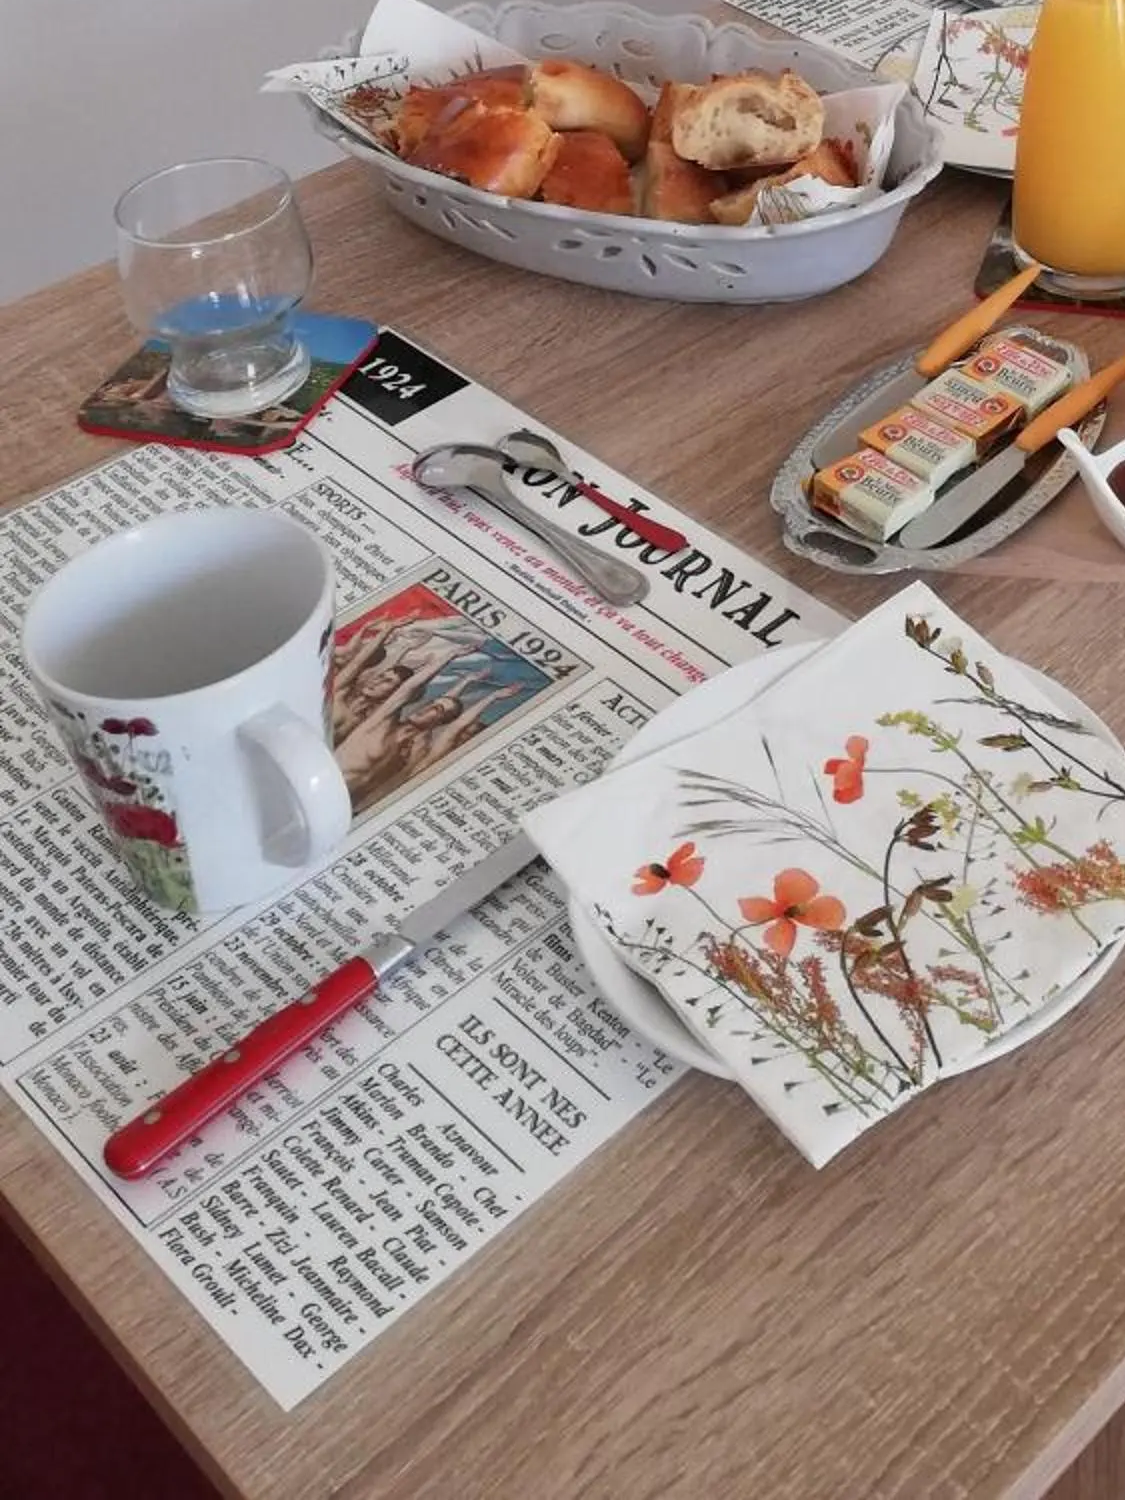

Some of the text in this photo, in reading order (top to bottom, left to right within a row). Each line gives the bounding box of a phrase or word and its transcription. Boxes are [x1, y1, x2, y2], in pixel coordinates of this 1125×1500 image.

[357, 354, 418, 401] 1924
[311, 483, 366, 520] SPORTS
[421, 568, 507, 628] PARIS
[507, 631, 581, 681] 1924
[540, 565, 589, 598] monde
[630, 626, 666, 652] tout
[32, 825, 72, 866] Marquis
[71, 836, 102, 868] vaccin
[18, 941, 53, 976] mètres
[23, 915, 50, 939] avec
[33, 892, 69, 926] monde
[81, 941, 124, 984] distance
[66, 895, 111, 942] Argentin,
[542, 933, 573, 962] films
[25, 981, 51, 1006] tour
[176, 989, 208, 1015] juin
[496, 970, 536, 1012] Miracle
[533, 1009, 555, 1030] des
[511, 956, 548, 993] Voleur
[545, 961, 585, 996] Buster
[587, 997, 630, 1038] Keaton
[107, 1050, 137, 1074] août
[436, 1034, 569, 1155] CETTE ANNEE
[458, 1014, 586, 1128] ILS SONT NES
[338, 1093, 479, 1226] Atkins Truman Capote
[358, 1076, 507, 1218] Marlon Brando Chet
[377, 1062, 498, 1175] Charles Aznavour
[260, 1148, 404, 1291] Sautet Lauren Bacall
[282, 1135, 429, 1283] Colette Renard Claude
[301, 1119, 436, 1253] François Jean Piat
[319, 1106, 361, 1145] Jimmy
[363, 1147, 404, 1185] Carter
[415, 1199, 467, 1250] Samson
[158, 1227, 235, 1308] Flora Groult
[179, 1210, 315, 1358] Bush Micheline Dax
[199, 1195, 347, 1352] Sidney Lumet George
[220, 1179, 258, 1217] Barre
[264, 1226, 298, 1255] Zizi
[290, 1256, 357, 1323] Jeanmaire
[241, 1164, 298, 1223] Franquin
[327, 1255, 393, 1317] Raymond
